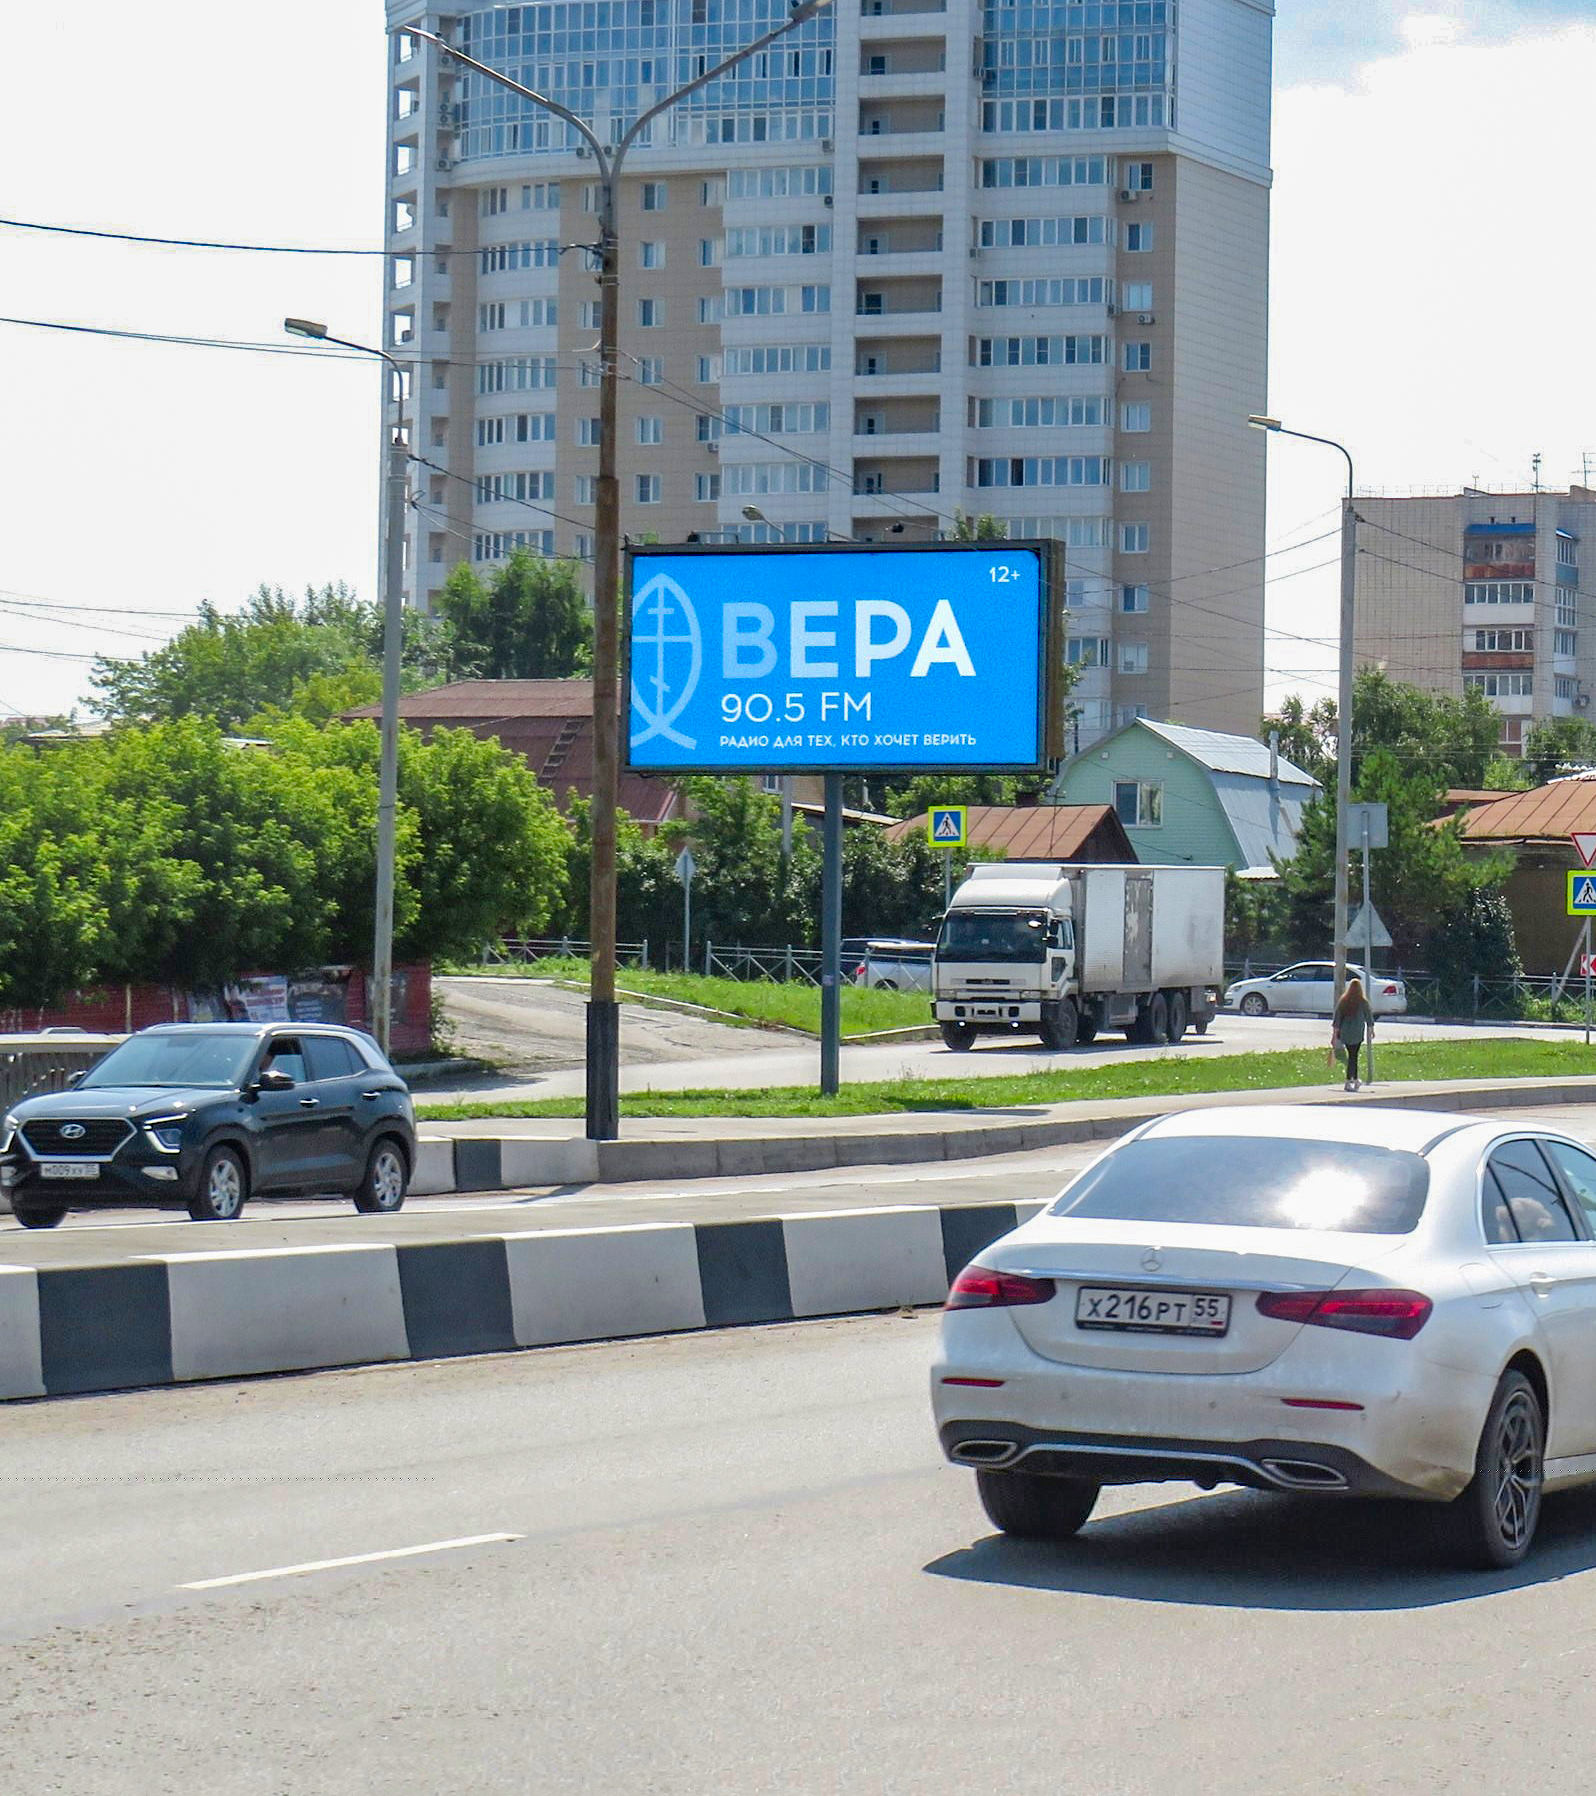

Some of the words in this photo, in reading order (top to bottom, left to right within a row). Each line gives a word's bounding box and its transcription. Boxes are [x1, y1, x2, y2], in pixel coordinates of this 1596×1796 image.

[989, 566, 1020, 582] 12+
[723, 599, 976, 678] ВЕРА
[722, 693, 805, 722] 90.5
[821, 692, 871, 721] FM
[720, 736, 769, 748] РАДИО
[773, 735, 802, 748] ДЛЯ
[841, 734, 869, 746] КТО
[874, 734, 919, 746] ХОЧЕТ
[924, 734, 976, 745] ВЕРИТЬ
[1087, 1293, 1187, 1322] Х216РТ
[1194, 1297, 1219, 1317] 55
